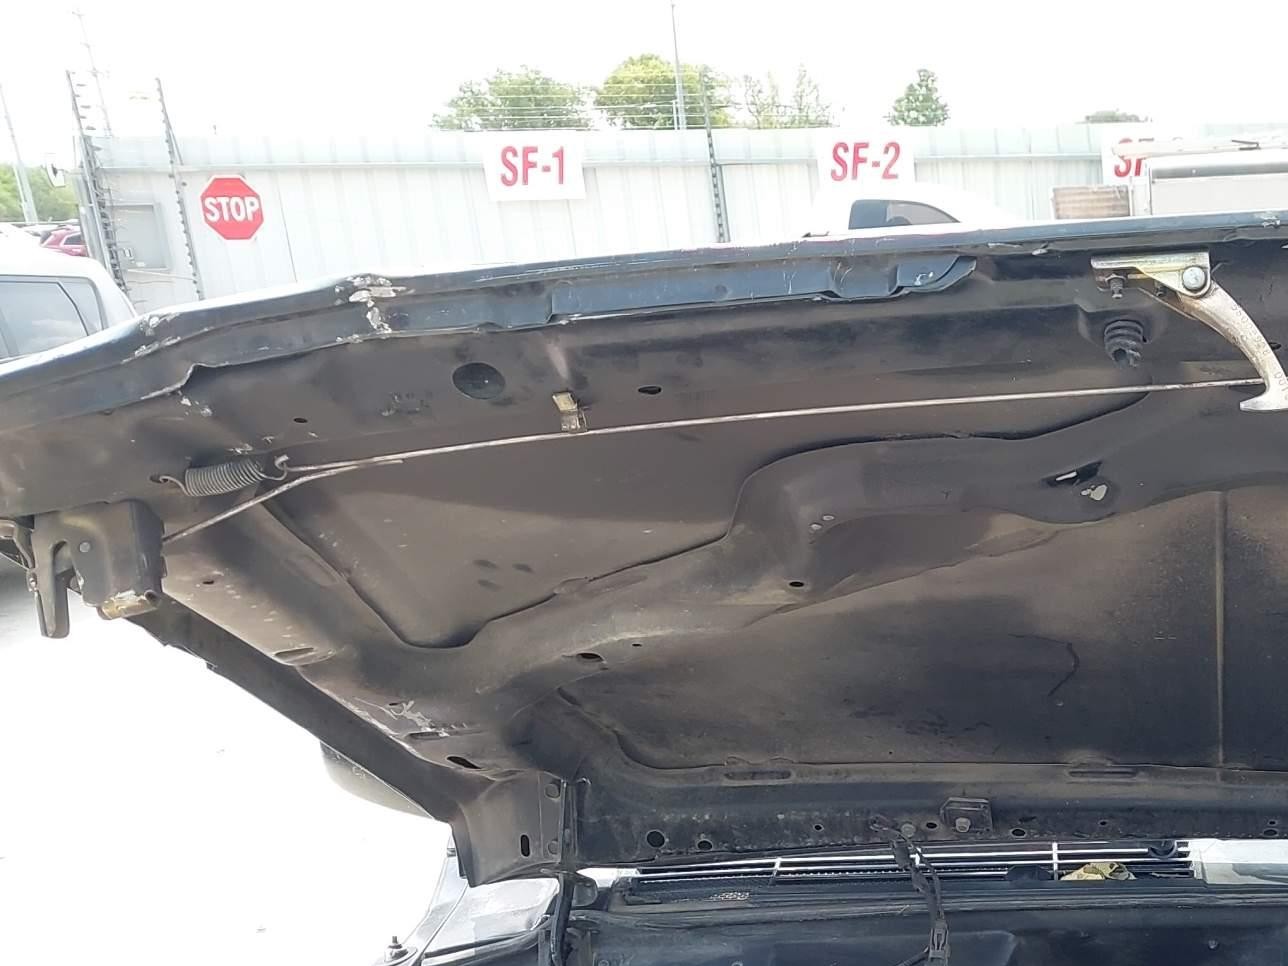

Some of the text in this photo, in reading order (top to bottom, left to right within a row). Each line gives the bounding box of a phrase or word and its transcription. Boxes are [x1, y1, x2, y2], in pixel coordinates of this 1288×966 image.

[500, 145, 564, 187] SF-1
[831, 142, 901, 181] SF-2
[204, 196, 260, 222] STOP
